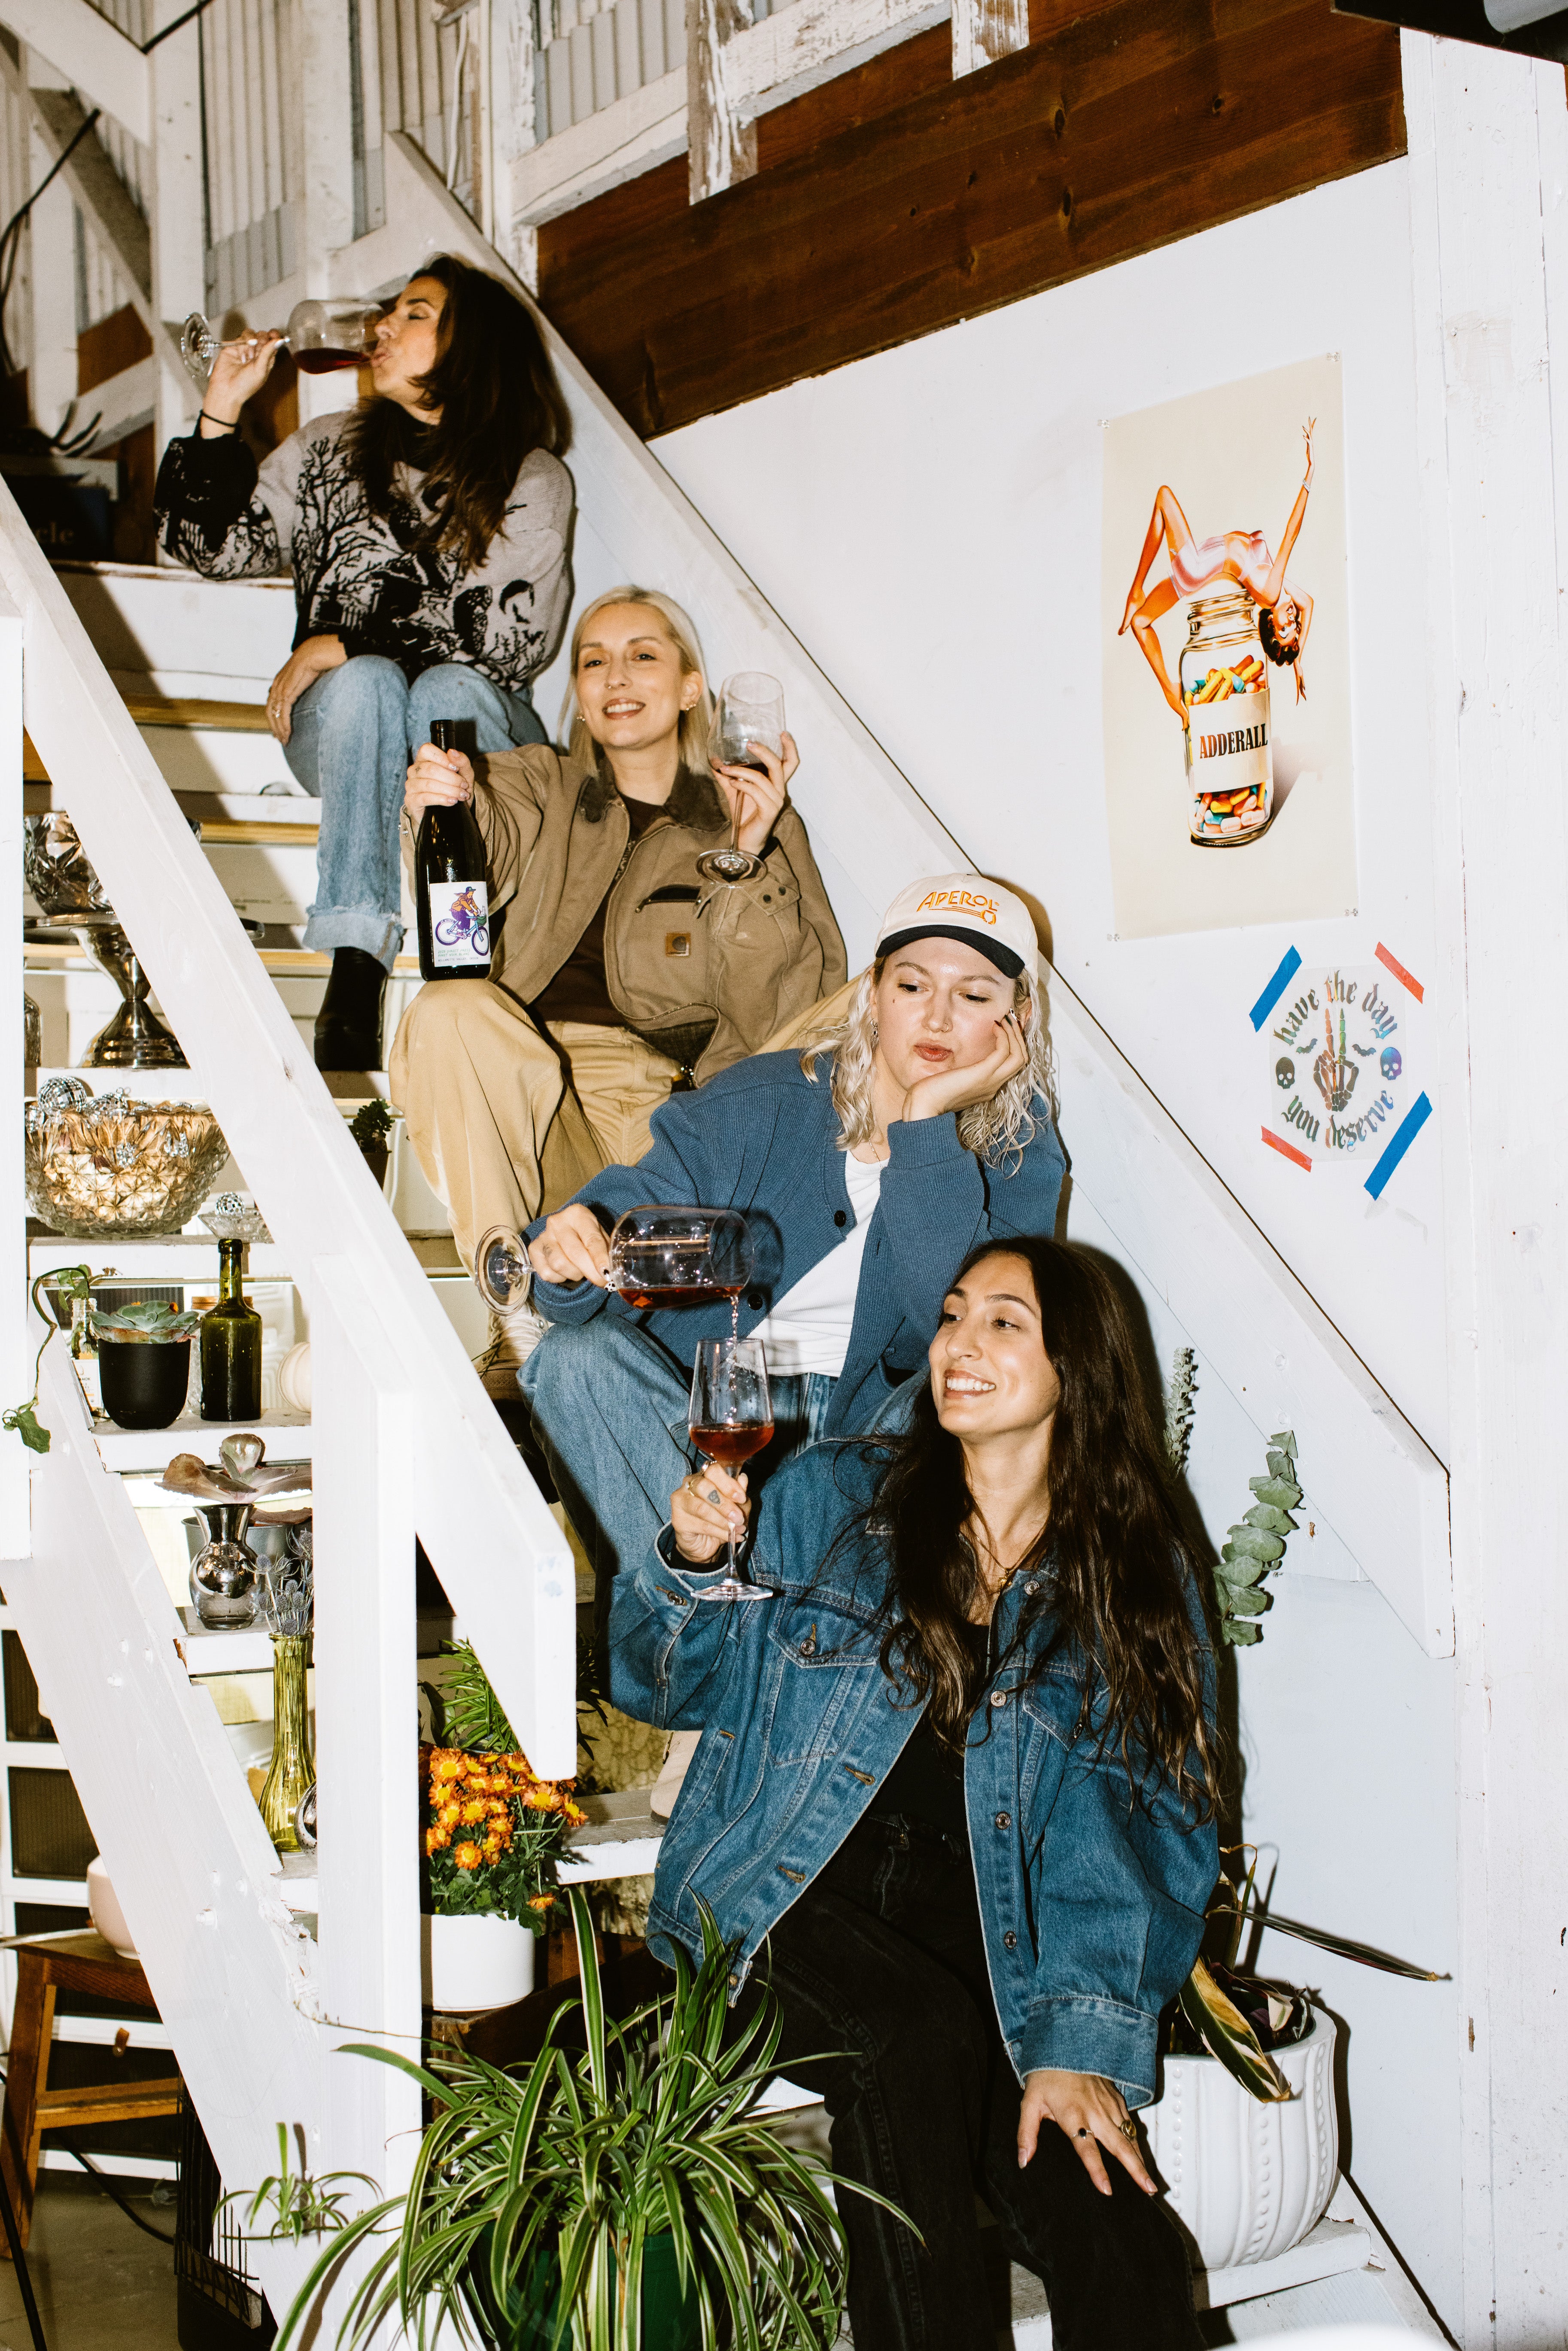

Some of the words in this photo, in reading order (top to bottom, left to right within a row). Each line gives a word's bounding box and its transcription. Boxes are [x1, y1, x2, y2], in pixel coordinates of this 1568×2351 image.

[1200, 723, 1268, 759] ADDERALL
[916, 890, 998, 912] APEROL
[1273, 989, 1319, 1046] have
[1324, 970, 1357, 1004] the
[1361, 983, 1398, 1039] day
[1281, 1095, 1320, 1142] you
[1325, 1090, 1394, 1152] deserve
